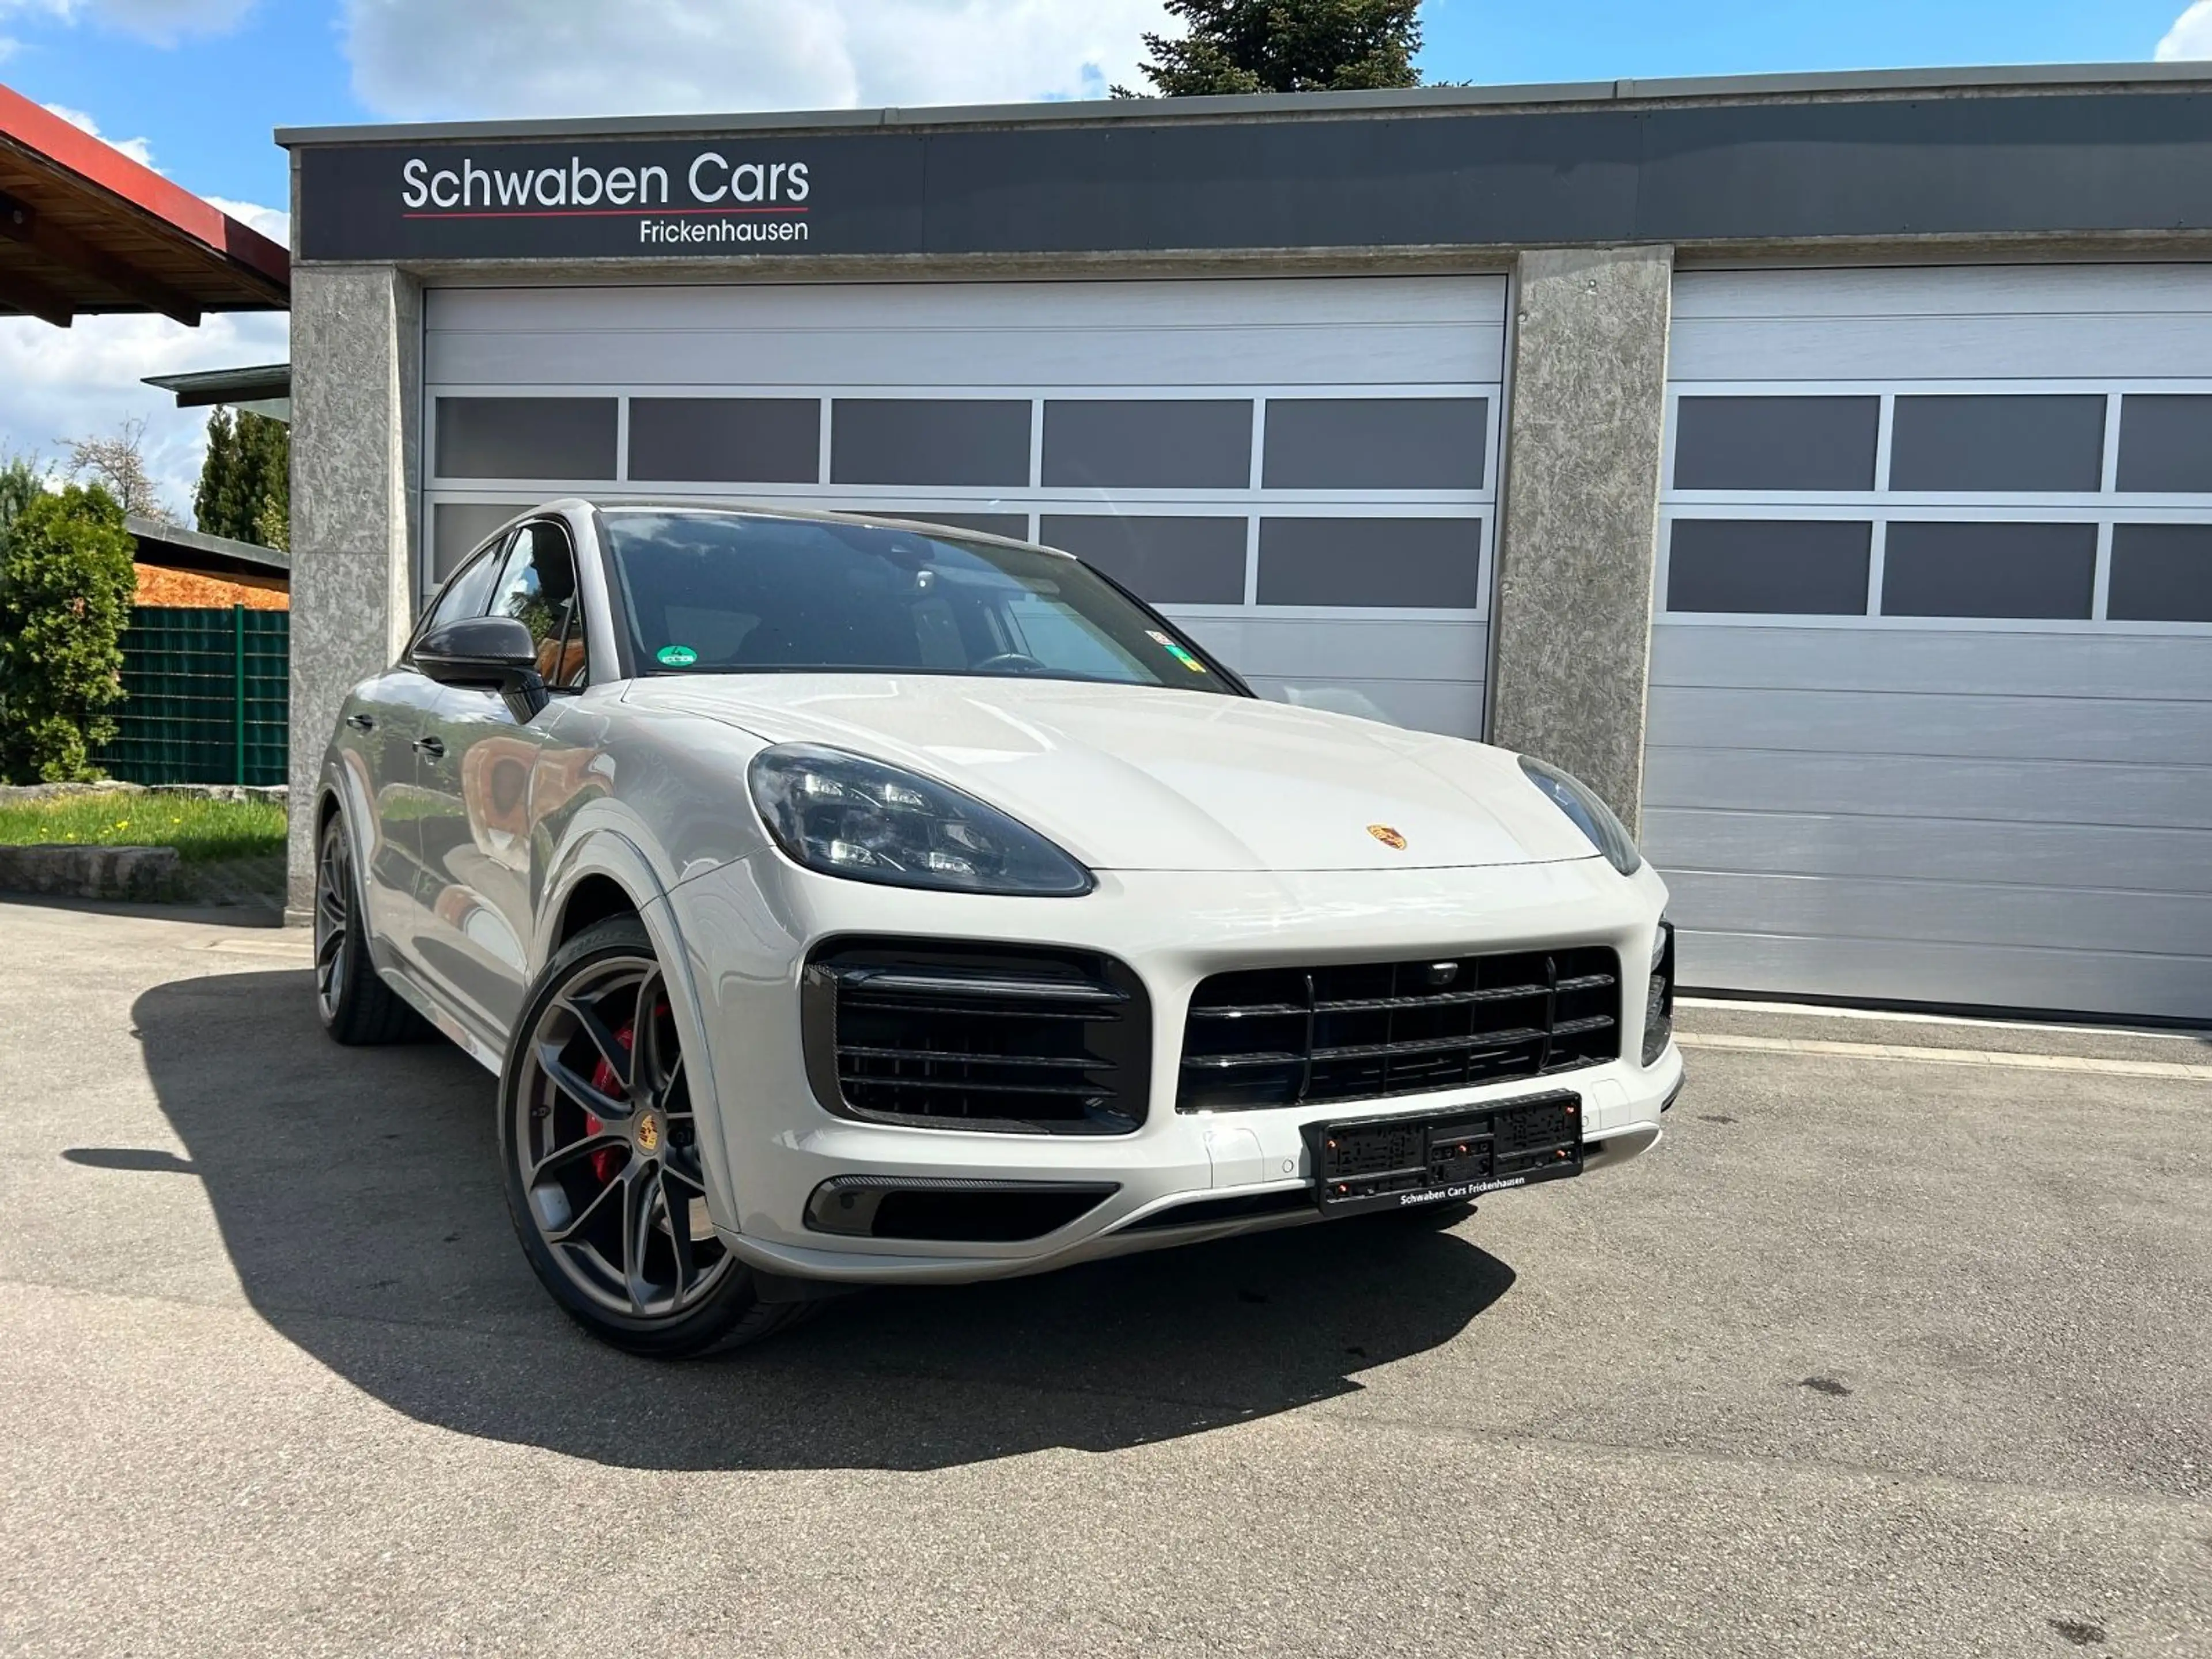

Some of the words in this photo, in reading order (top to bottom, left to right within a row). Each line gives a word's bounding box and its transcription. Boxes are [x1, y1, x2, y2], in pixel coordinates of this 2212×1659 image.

[402, 156, 668, 208] Schwaben
[689, 152, 809, 203] Cars
[641, 219, 808, 243] Frickenhausen
[1400, 1190, 1445, 1205] Schwaben
[1448, 1187, 1467, 1196] Cars
[1468, 1177, 1525, 1194] Frickenhausen
